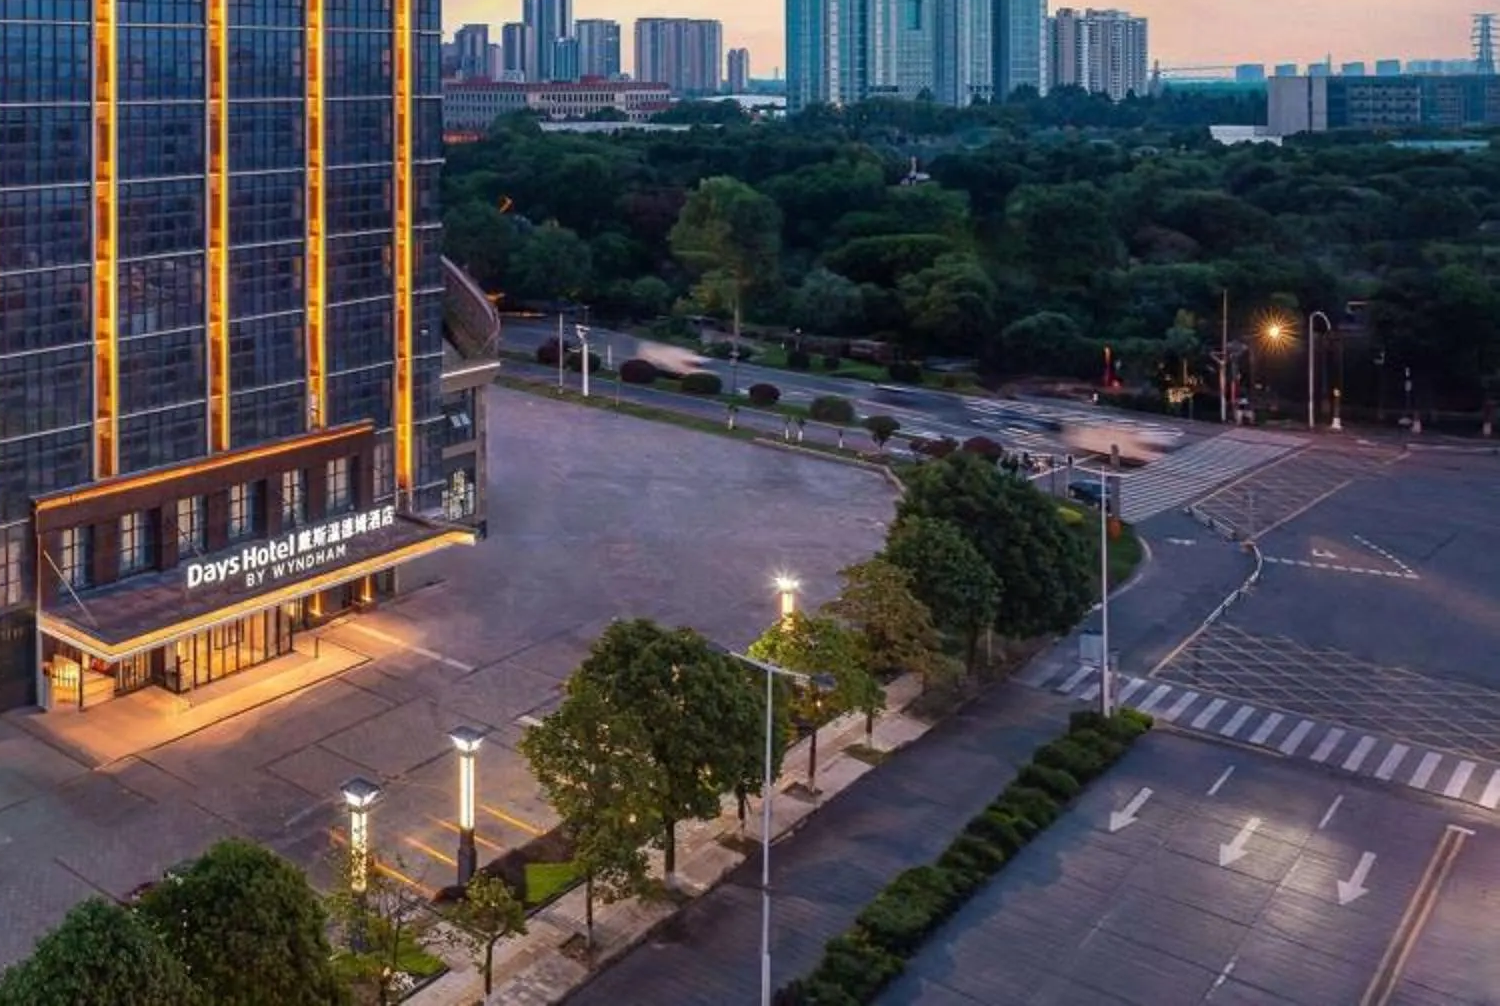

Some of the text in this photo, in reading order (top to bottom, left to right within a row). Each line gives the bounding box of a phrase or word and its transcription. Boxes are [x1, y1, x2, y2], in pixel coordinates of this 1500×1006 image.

[187, 505, 395, 588] Days Hotel 戴斯温德姆酒店
[246, 544, 347, 587] BY WYNDHAM
